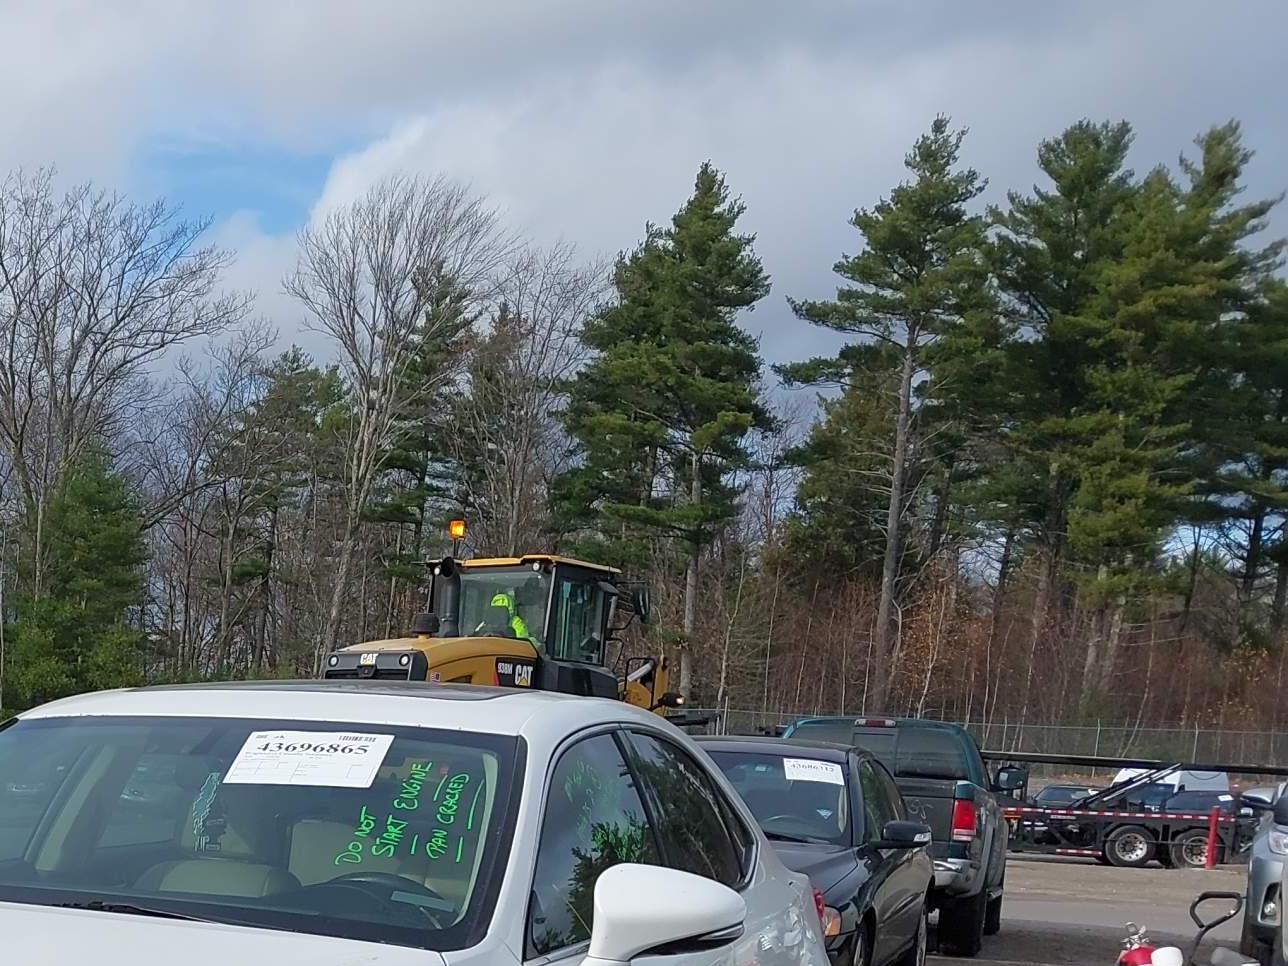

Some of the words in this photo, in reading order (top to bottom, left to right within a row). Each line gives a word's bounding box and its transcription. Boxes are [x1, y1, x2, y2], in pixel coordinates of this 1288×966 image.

[360, 653, 378, 665] CAT
[514, 664, 533, 687] CAT
[256, 742, 370, 755] 43696865
[335, 841, 363, 865] DO
[354, 806, 376, 838] NOT
[371, 814, 409, 858] START
[425, 829, 448, 859] PAN
